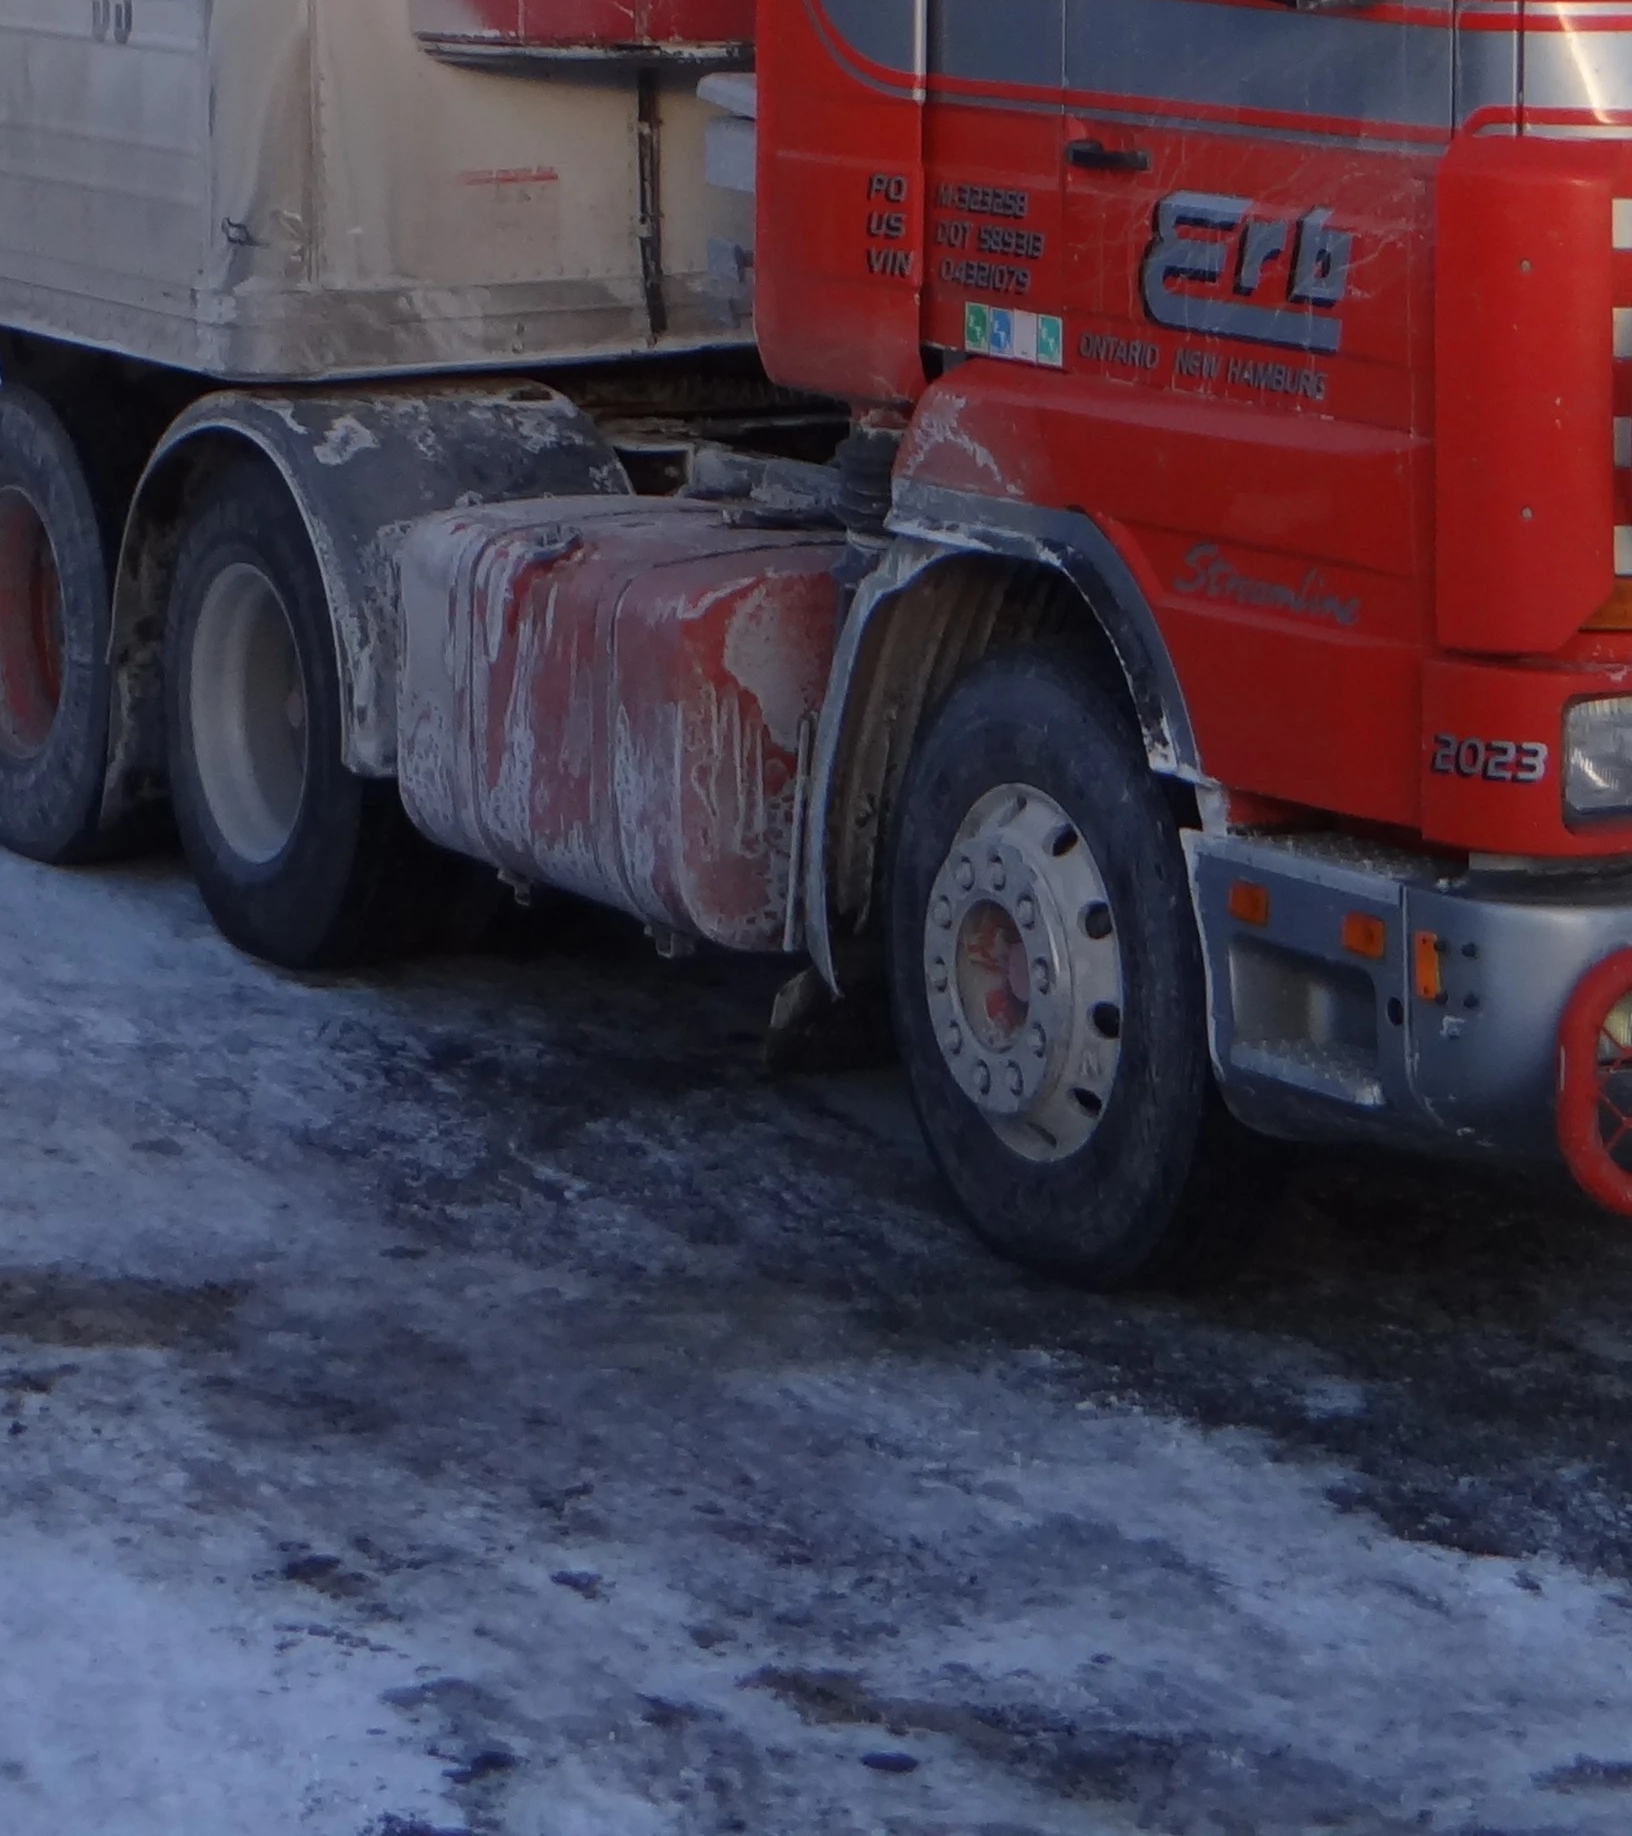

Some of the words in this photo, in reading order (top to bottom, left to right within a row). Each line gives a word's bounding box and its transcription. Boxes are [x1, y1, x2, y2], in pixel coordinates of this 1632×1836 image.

[866, 211, 907, 239] US
[935, 220, 974, 248] DOT
[867, 247, 915, 278] VIN
[1141, 189, 1354, 355] Erb
[1079, 331, 1160, 370] ONTARIO
[1173, 347, 1221, 377] NEW
[1226, 356, 1328, 400] HAMBURG
[1172, 539, 1361, 627] Streamline
[1431, 732, 1549, 784] 2023
